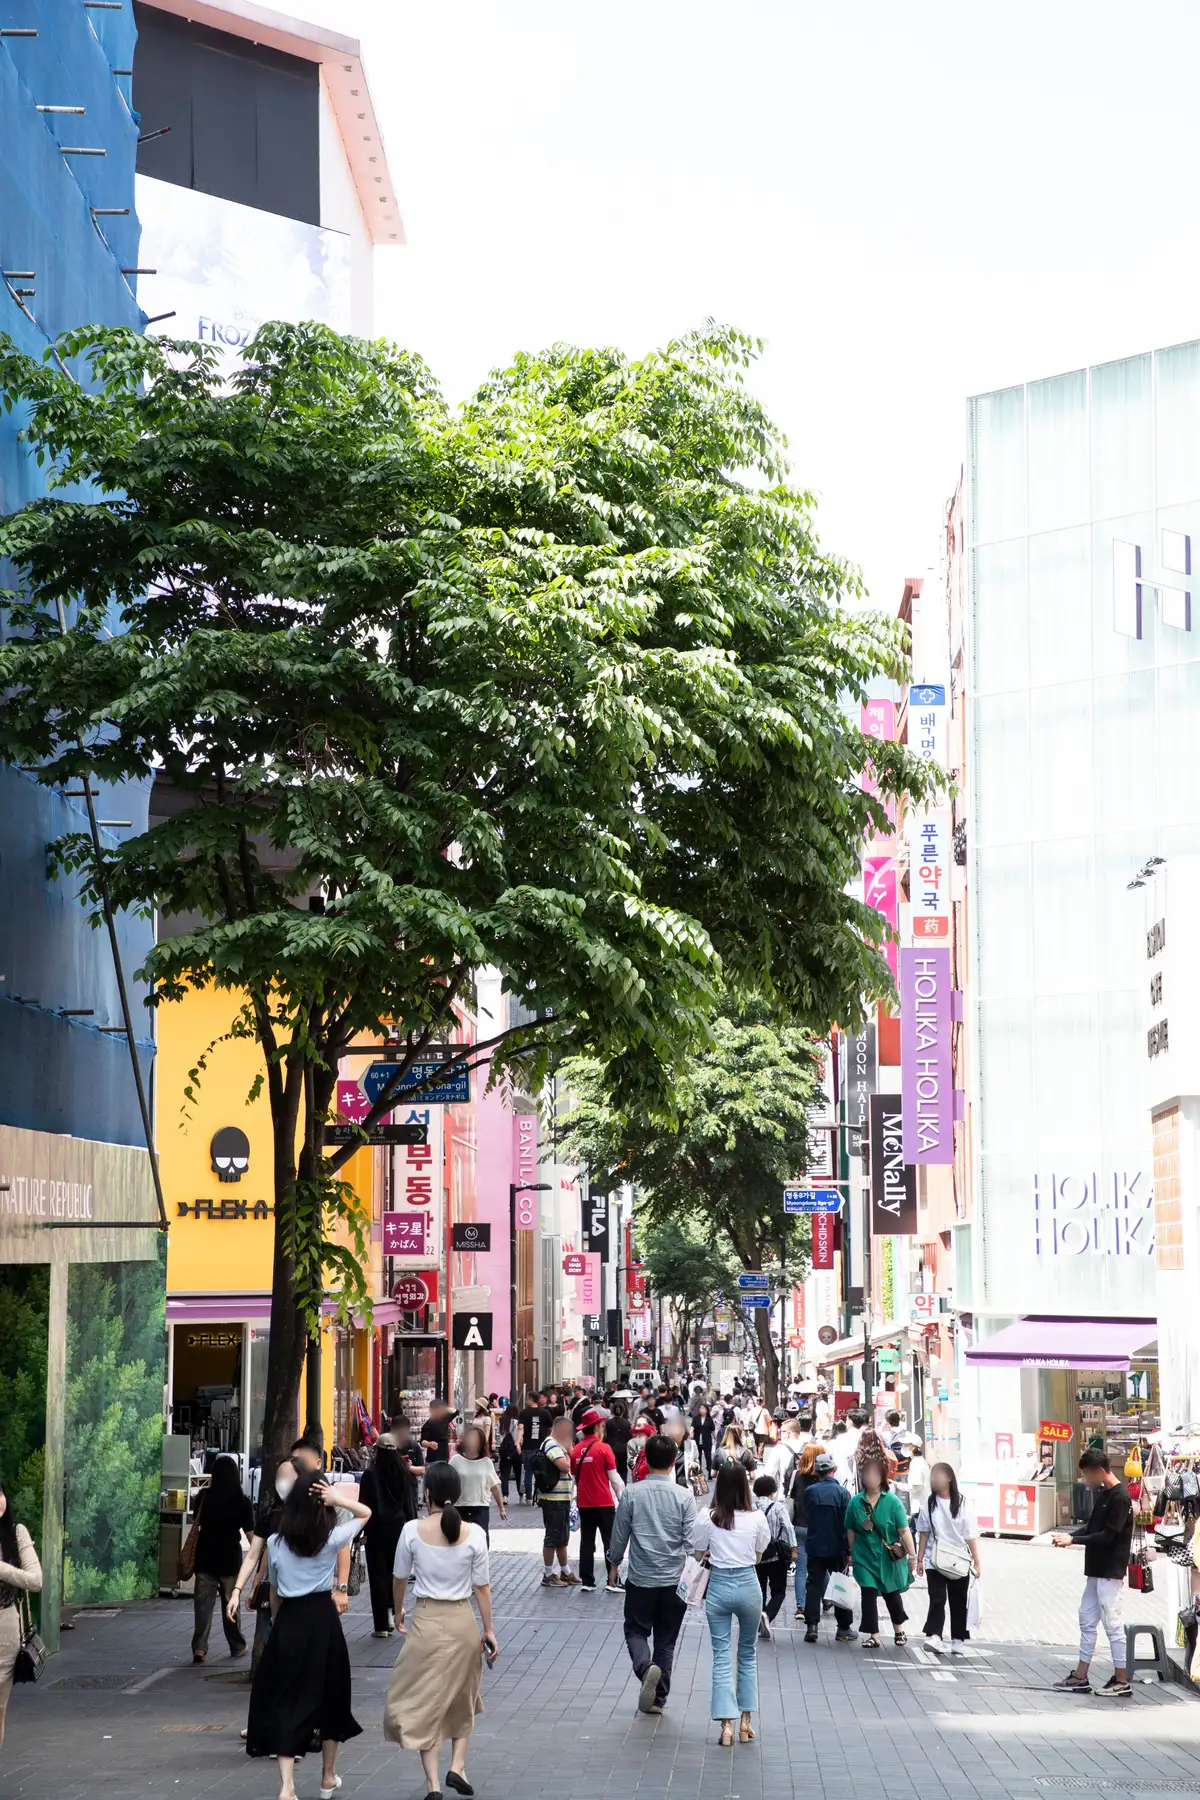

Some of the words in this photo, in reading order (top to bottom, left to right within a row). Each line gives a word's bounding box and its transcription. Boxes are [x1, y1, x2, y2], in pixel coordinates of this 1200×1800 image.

[198, 315, 251, 348] FROZ
[914, 958, 938, 1052] HOLIKA
[856, 1031, 867, 1075] MOON
[916, 1059, 940, 1153] HOLIKA
[520, 1120, 533, 1189] BANILA
[1, 1175, 47, 1216] NATURE
[49, 1180, 93, 1219] REPUBLIC
[1034, 1171, 1153, 1210] HOLIK
[195, 1199, 247, 1220] FLEX
[520, 1197, 533, 1225] CO
[591, 1196, 606, 1237] FILA
[385, 1222, 423, 1236] キラ星
[390, 1239, 418, 1249] かばん
[455, 1241, 487, 1249] MISSHA
[818, 1212, 828, 1263] RCHIDSKIN
[1034, 1216, 1155, 1255] HOLIK
[914, 1295, 935, 1317] 약
[1022, 1358, 1046, 1366] HOLIKA
[1046, 1359, 1069, 1367] HOLIKA
[1043, 1426, 1069, 1438] SALE
